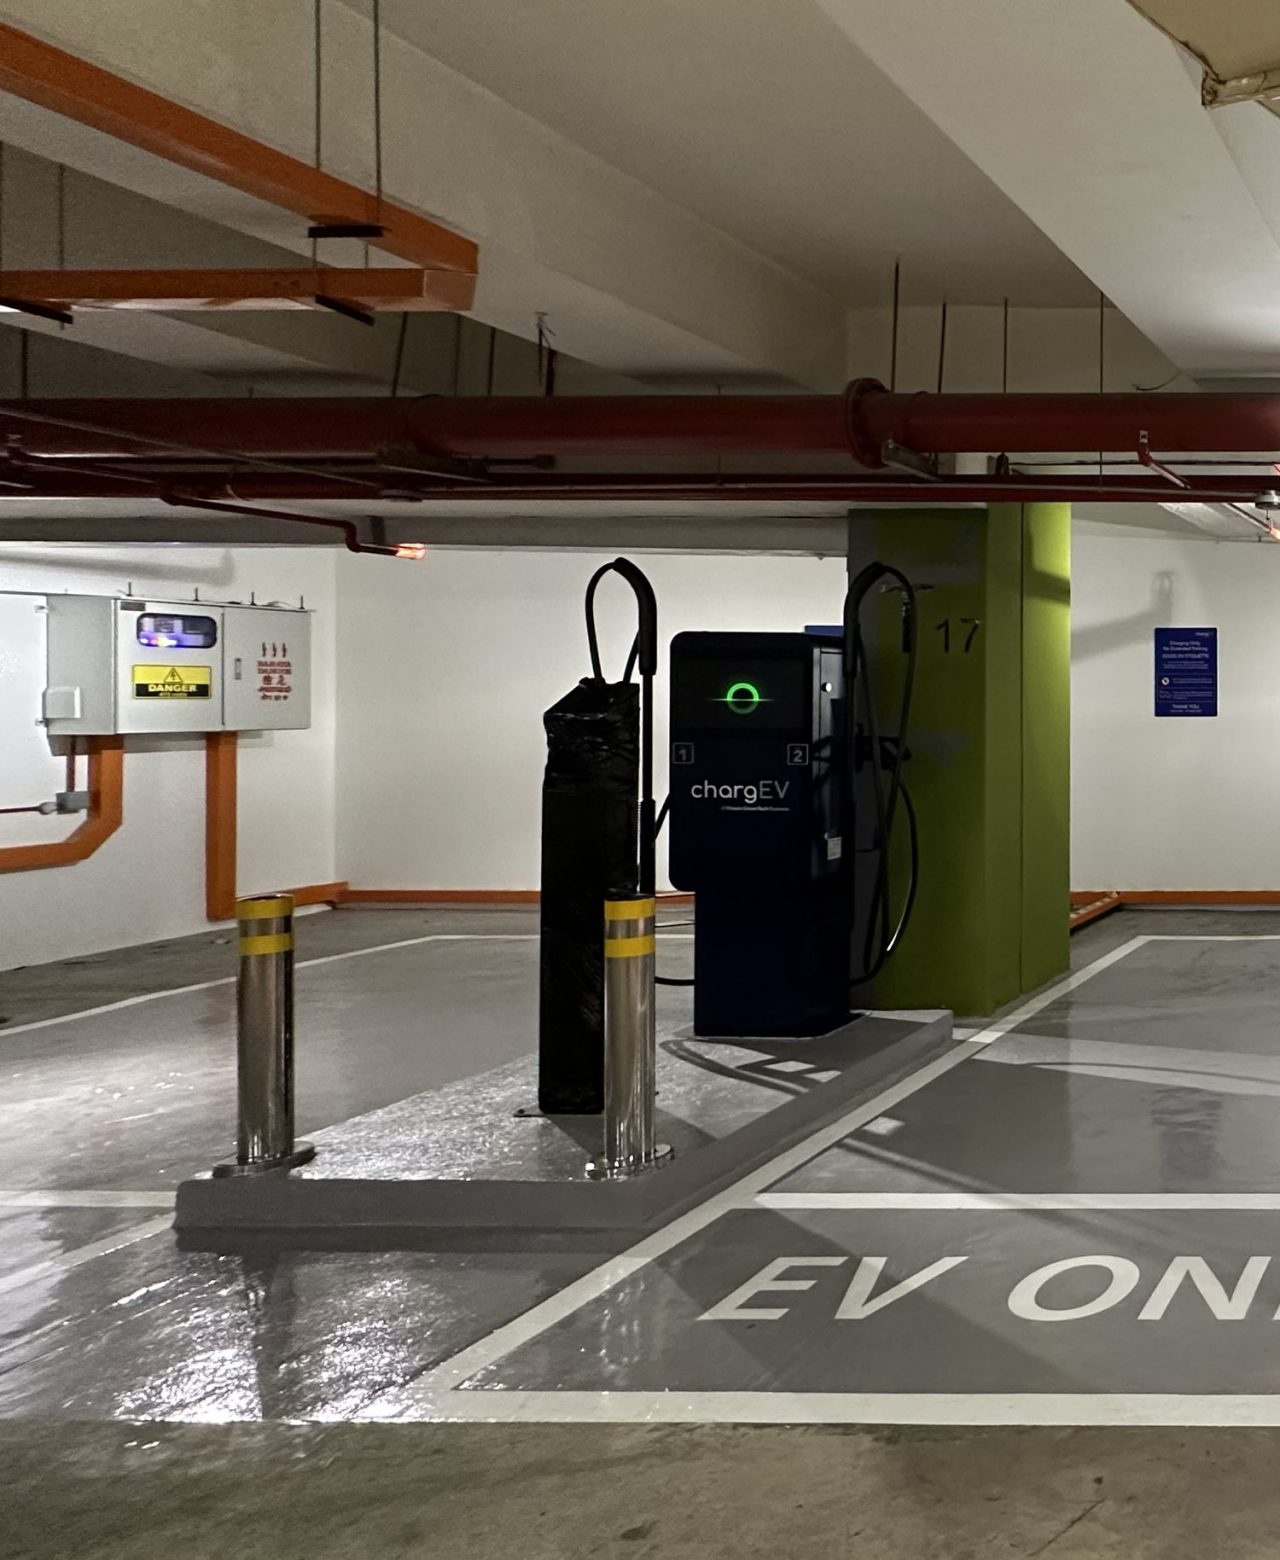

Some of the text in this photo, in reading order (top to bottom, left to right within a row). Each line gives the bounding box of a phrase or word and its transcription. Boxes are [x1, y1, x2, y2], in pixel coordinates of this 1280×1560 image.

[934, 617, 980, 653] 17
[148, 684, 197, 692] DANGER
[678, 748, 687, 762] 1
[792, 749, 803, 763] 2
[690, 779, 790, 804] chargEV
[697, 1255, 971, 1323] EV
